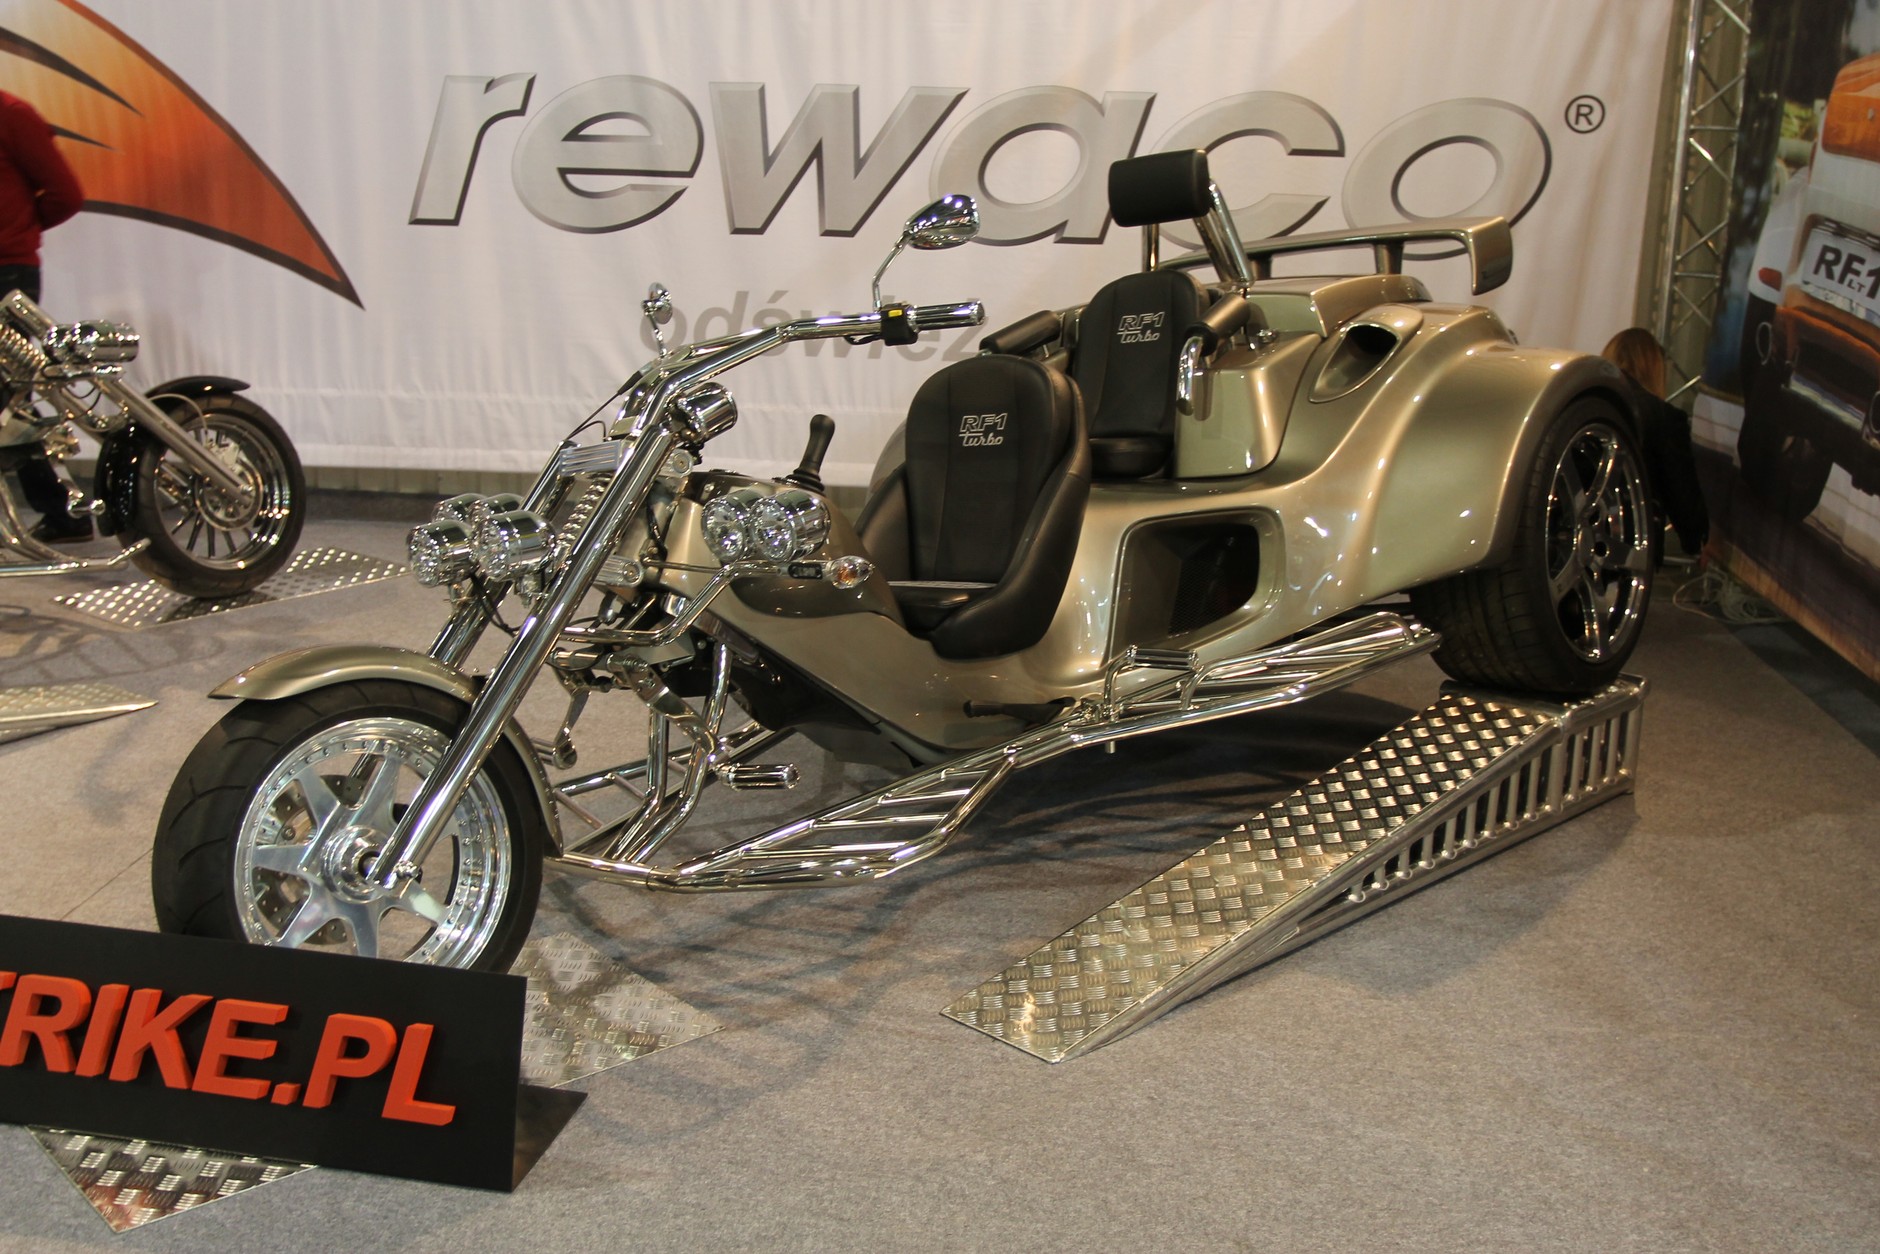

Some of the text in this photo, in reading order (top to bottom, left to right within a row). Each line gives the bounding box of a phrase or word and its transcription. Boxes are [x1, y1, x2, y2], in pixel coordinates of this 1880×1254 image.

[408, 72, 1552, 261] rewaco
[1118, 311, 1165, 331] RF1
[960, 412, 1008, 432] RF1
